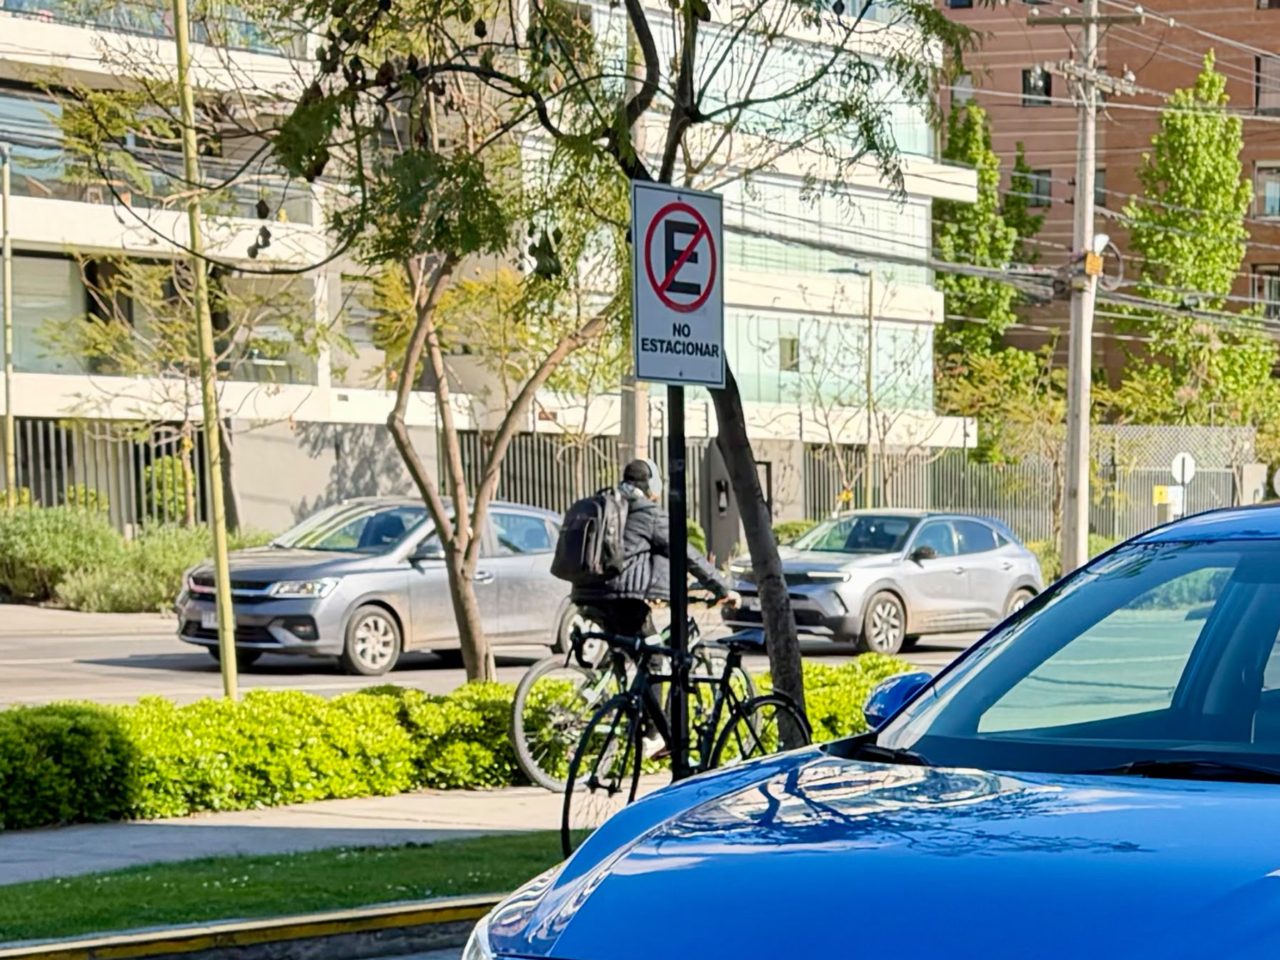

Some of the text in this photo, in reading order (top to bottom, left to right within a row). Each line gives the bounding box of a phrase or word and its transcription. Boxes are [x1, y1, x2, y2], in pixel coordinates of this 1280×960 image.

[664, 219, 701, 295] E
[672, 323, 691, 338] NO
[641, 338, 719, 358] ESTACIONAR
